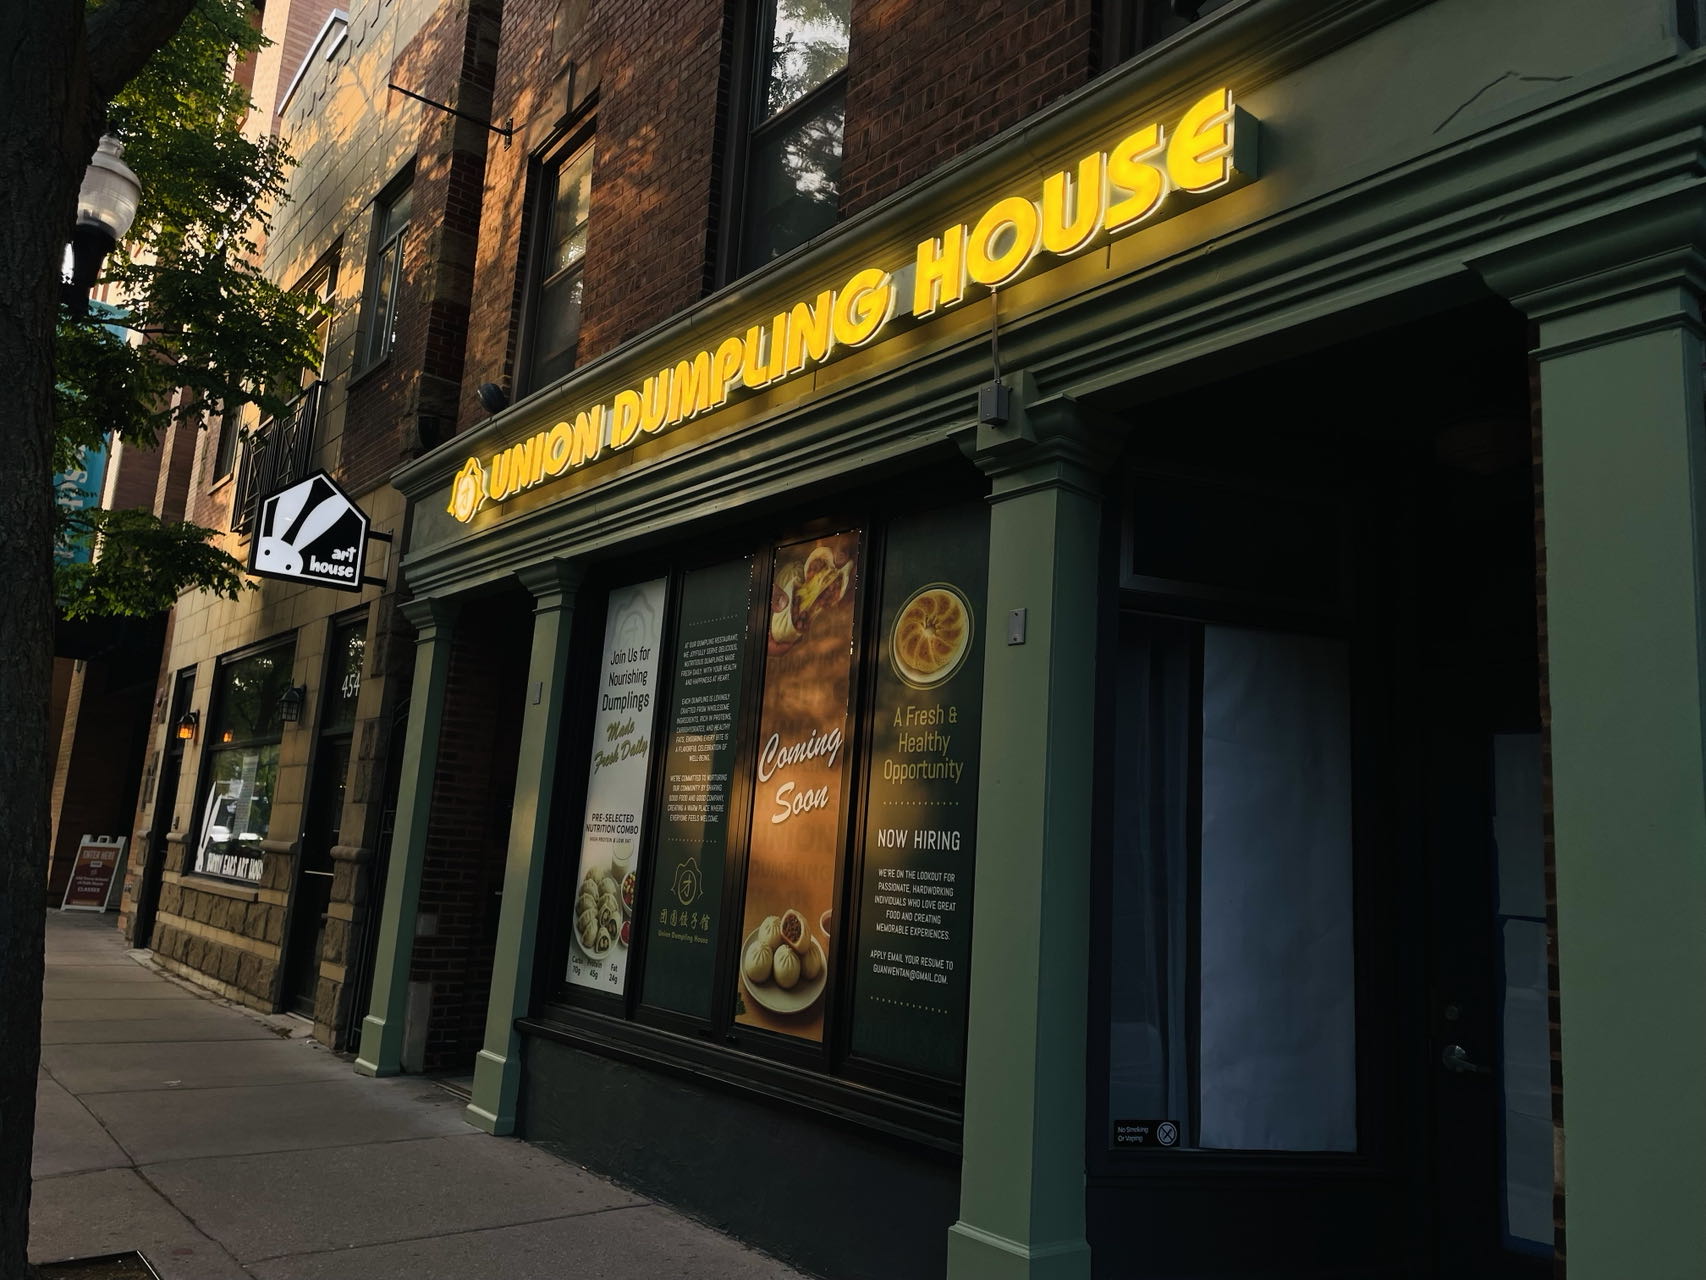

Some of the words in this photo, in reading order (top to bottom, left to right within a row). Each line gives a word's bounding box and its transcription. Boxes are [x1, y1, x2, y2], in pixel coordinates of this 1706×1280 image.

[490, 404, 604, 501] UNION
[610, 267, 896, 449] DUMPLING
[912, 86, 1234, 319] HOUSE
[331, 546, 357, 563] art
[309, 555, 354, 578] house
[610, 649, 626, 666] Join
[627, 648, 638, 663] Us
[639, 646, 651, 661] for
[341, 672, 360, 699] 454
[608, 668, 648, 688] Nourishing
[602, 690, 650, 714] Dumplings
[893, 706, 902, 727] A
[906, 704, 944, 727] Fresh
[948, 706, 958, 724] &
[606, 717, 635, 742] Made
[898, 731, 951, 757] Healthy
[593, 744, 620, 775] Fresh
[620, 736, 648, 761] Daily
[758, 727, 843, 782] Coming
[883, 757, 964, 785] Opportunity
[771, 781, 829, 824] Soon
[592, 813, 635, 823] PRE-SELECTED
[586, 824, 616, 834] NUTRITION
[616, 825, 639, 835] COMBO
[877, 828, 908, 848] NOW
[914, 830, 961, 851] HIRING
[222, 854, 238, 876] EARS
[236, 856, 250, 878] ART
[878, 868, 896, 878] WE'RE
[896, 869, 905, 878] ON
[905, 870, 916, 880] THE
[916, 871, 943, 882] LOOKOUT
[943, 872, 956, 882] FOR
[878, 882, 911, 893] PASSIONATE,
[912, 884, 954, 897] HARDWORKING
[874, 895, 907, 907] INDIVIDUALS
[907, 898, 921, 908] WHO
[921, 899, 937, 910] LOVE
[937, 901, 956, 911] GREAT
[886, 910, 901, 920] FOOD
[901, 911, 913, 921] AND
[913, 912, 942, 925] CREATING
[658, 930, 671, 938] Union
[671, 931, 693, 943] Dumpling
[693, 935, 709, 944] House
[876, 922, 909, 935] MEMORABLE
[909, 926, 951, 941] EXPERIENCES.
[610, 963, 618, 972] Fat
[870, 949, 887, 960] APPLY
[887, 951, 904, 963] EMAIL
[904, 954, 919, 965] YOUR
[920, 956, 945, 969] RESUME
[945, 959, 954, 971] TO
[573, 965, 581, 976] 70g
[590, 969, 598, 980] 45g
[609, 973, 618, 985] 24g
[1125, 1135, 1143, 1143] Vaping
[1126, 1126, 1149, 1135] Smoking
